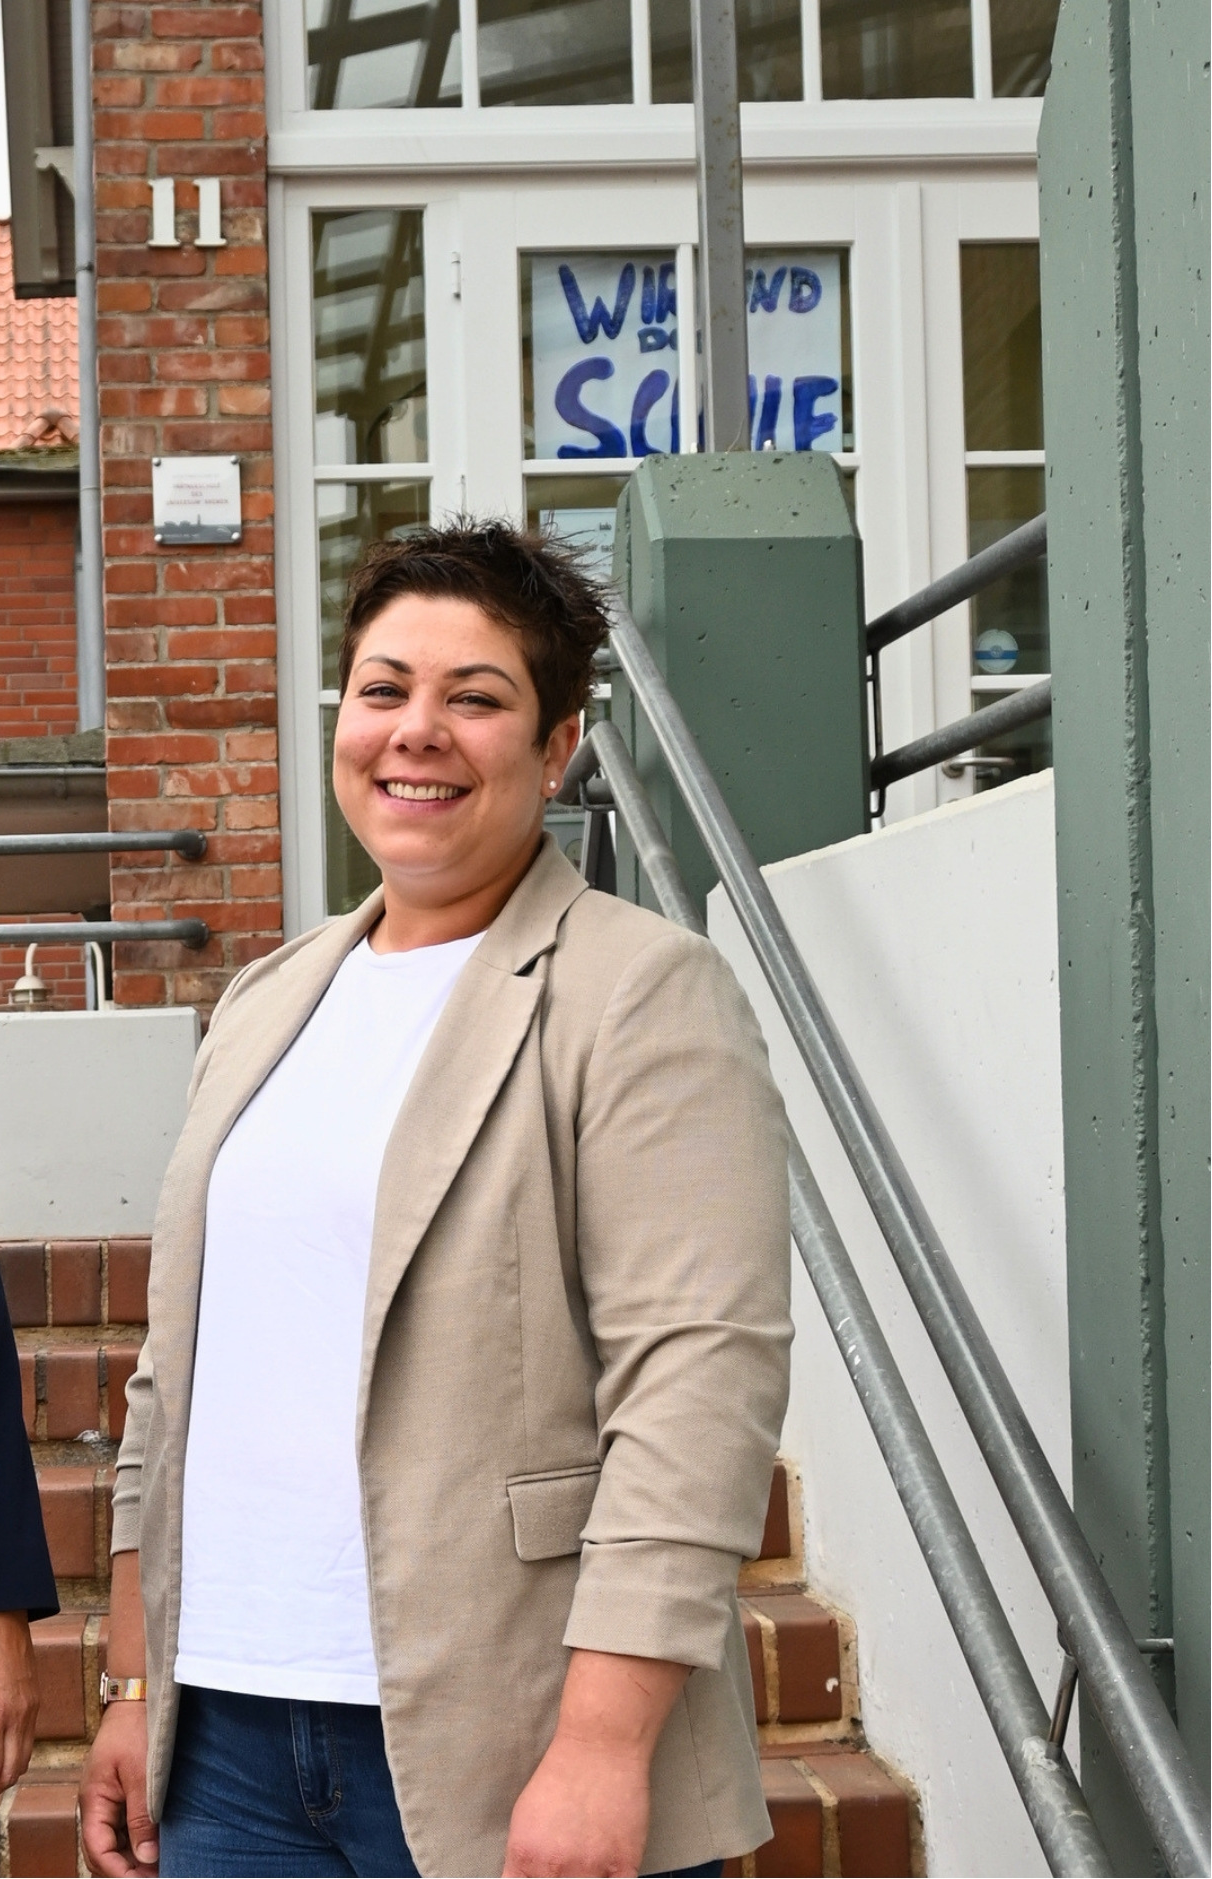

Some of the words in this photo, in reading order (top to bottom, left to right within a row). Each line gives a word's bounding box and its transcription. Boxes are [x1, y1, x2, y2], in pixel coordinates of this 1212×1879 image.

[148, 177, 227, 246] 11
[559, 262, 677, 344] WIR
[745, 265, 822, 313] ND
